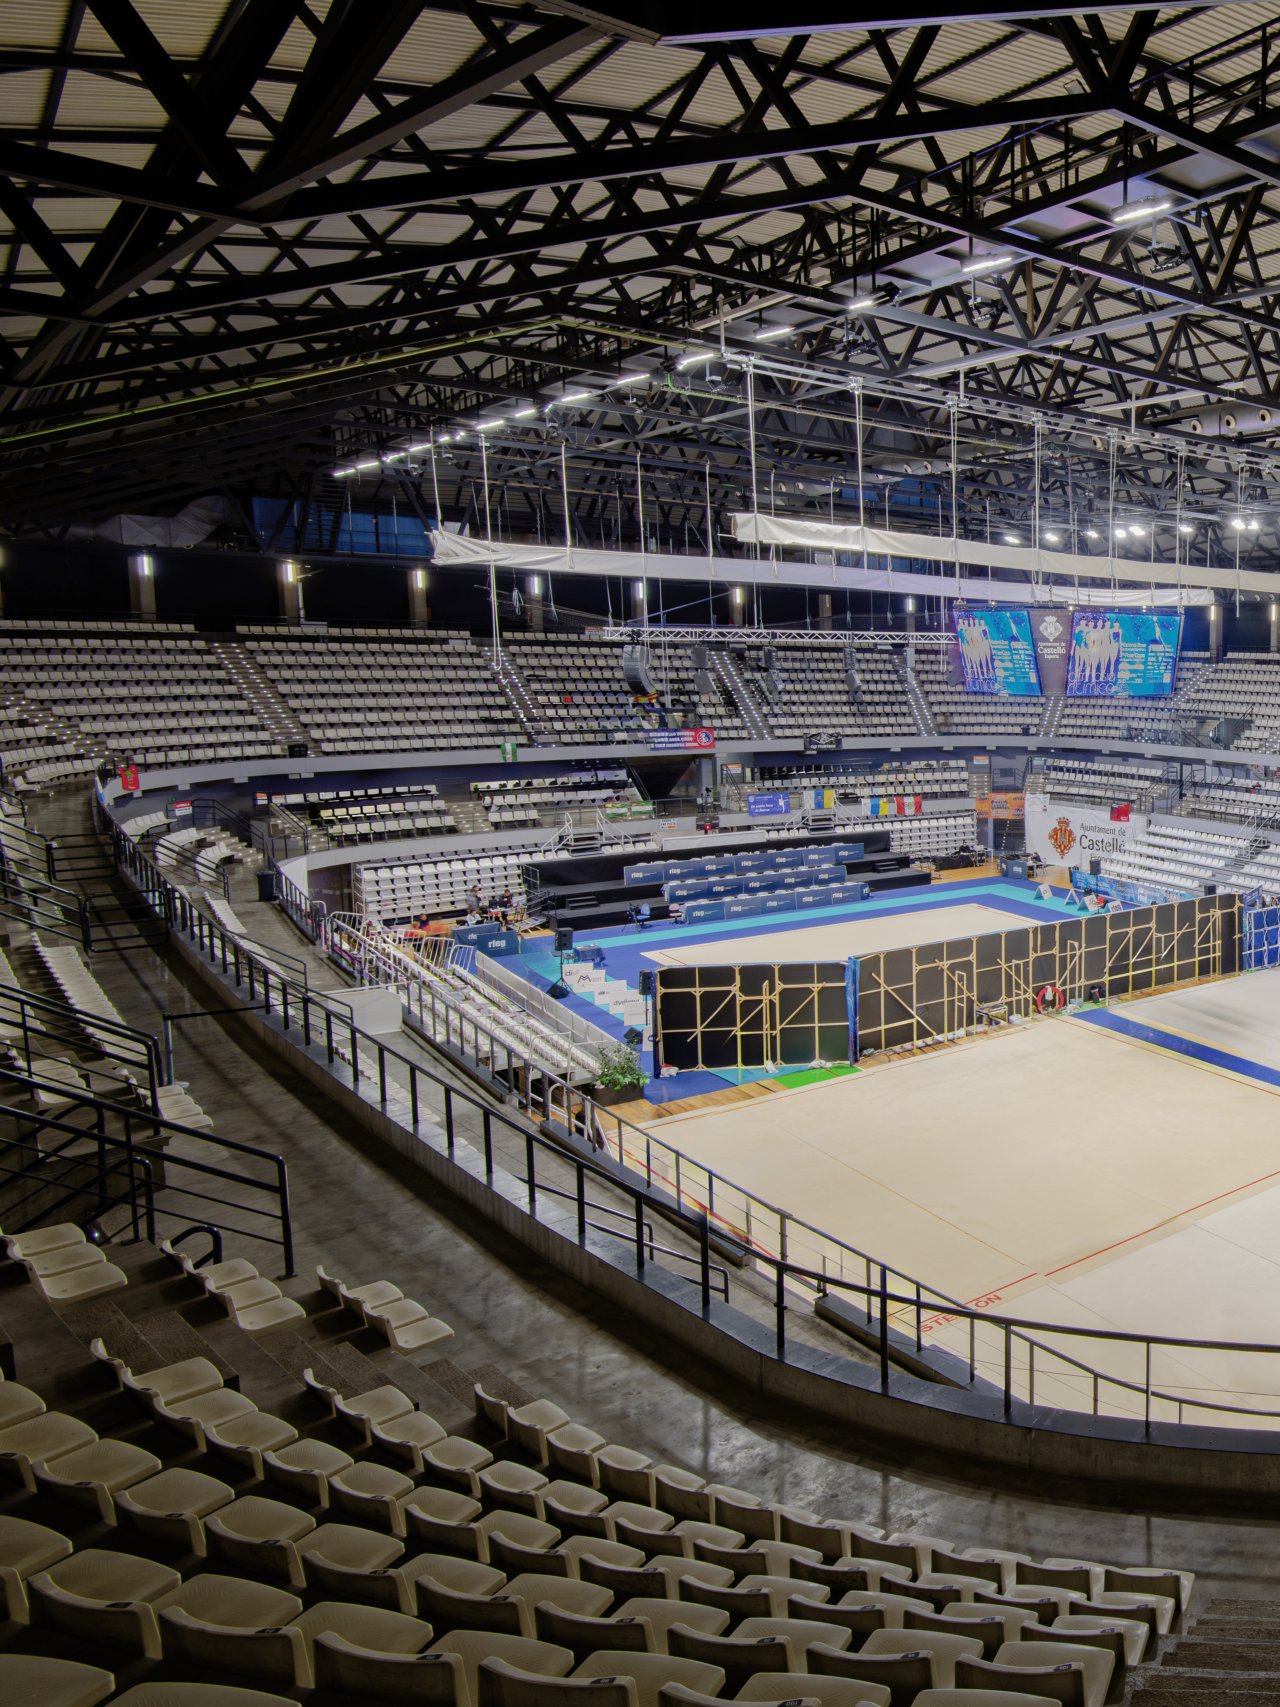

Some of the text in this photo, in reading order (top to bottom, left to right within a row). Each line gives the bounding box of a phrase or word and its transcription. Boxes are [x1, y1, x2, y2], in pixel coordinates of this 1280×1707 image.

[1080, 823, 1126, 836] Ajuntament de
[488, 939, 506, 948] rfeg
